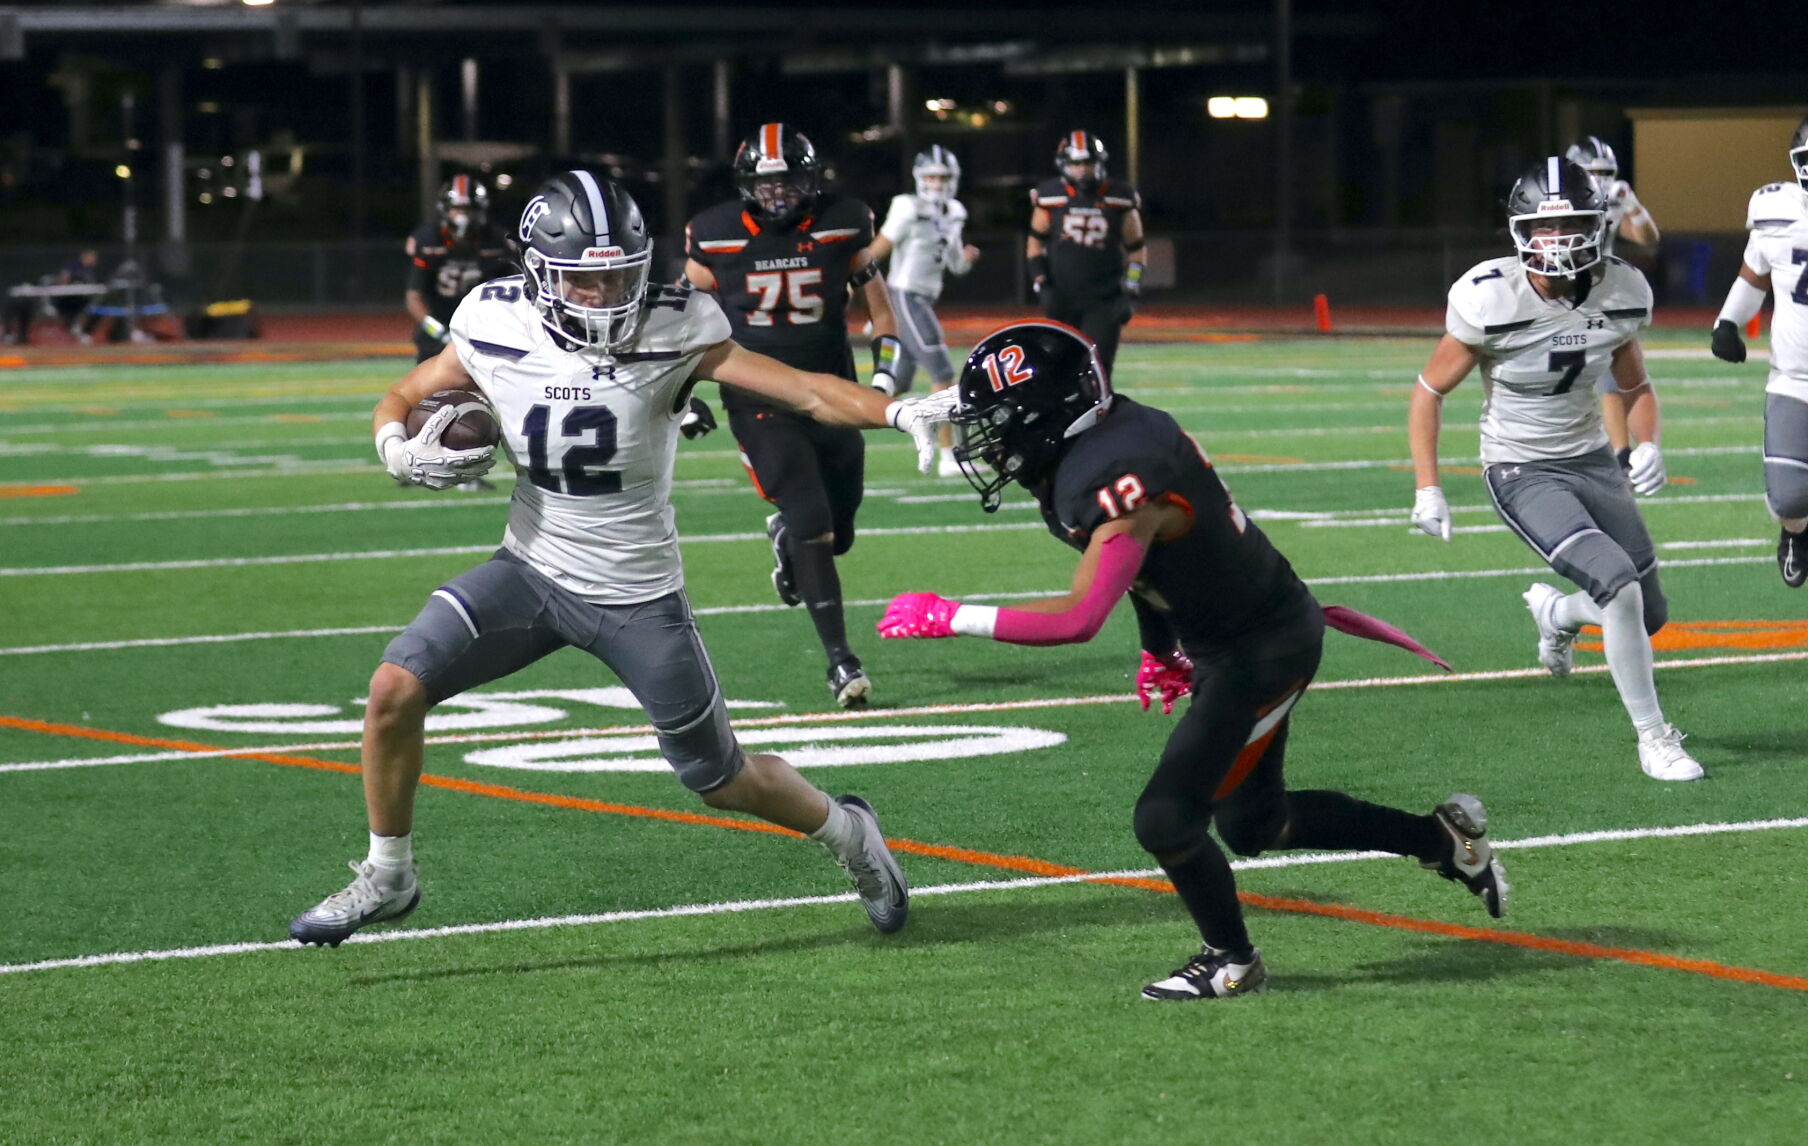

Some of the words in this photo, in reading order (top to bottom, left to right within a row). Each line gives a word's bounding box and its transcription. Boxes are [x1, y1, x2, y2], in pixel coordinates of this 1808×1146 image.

[588, 249, 622, 258] Riddell
[754, 257, 809, 271] BEARCATS
[1471, 268, 1505, 286] 7
[745, 268, 824, 327] 75
[1552, 334, 1587, 347] SCOTS
[982, 344, 1034, 393] 12
[1542, 350, 1586, 397] 7
[544, 386, 592, 401] SCOTS
[521, 403, 623, 496] 12
[1096, 473, 1147, 520] 12
